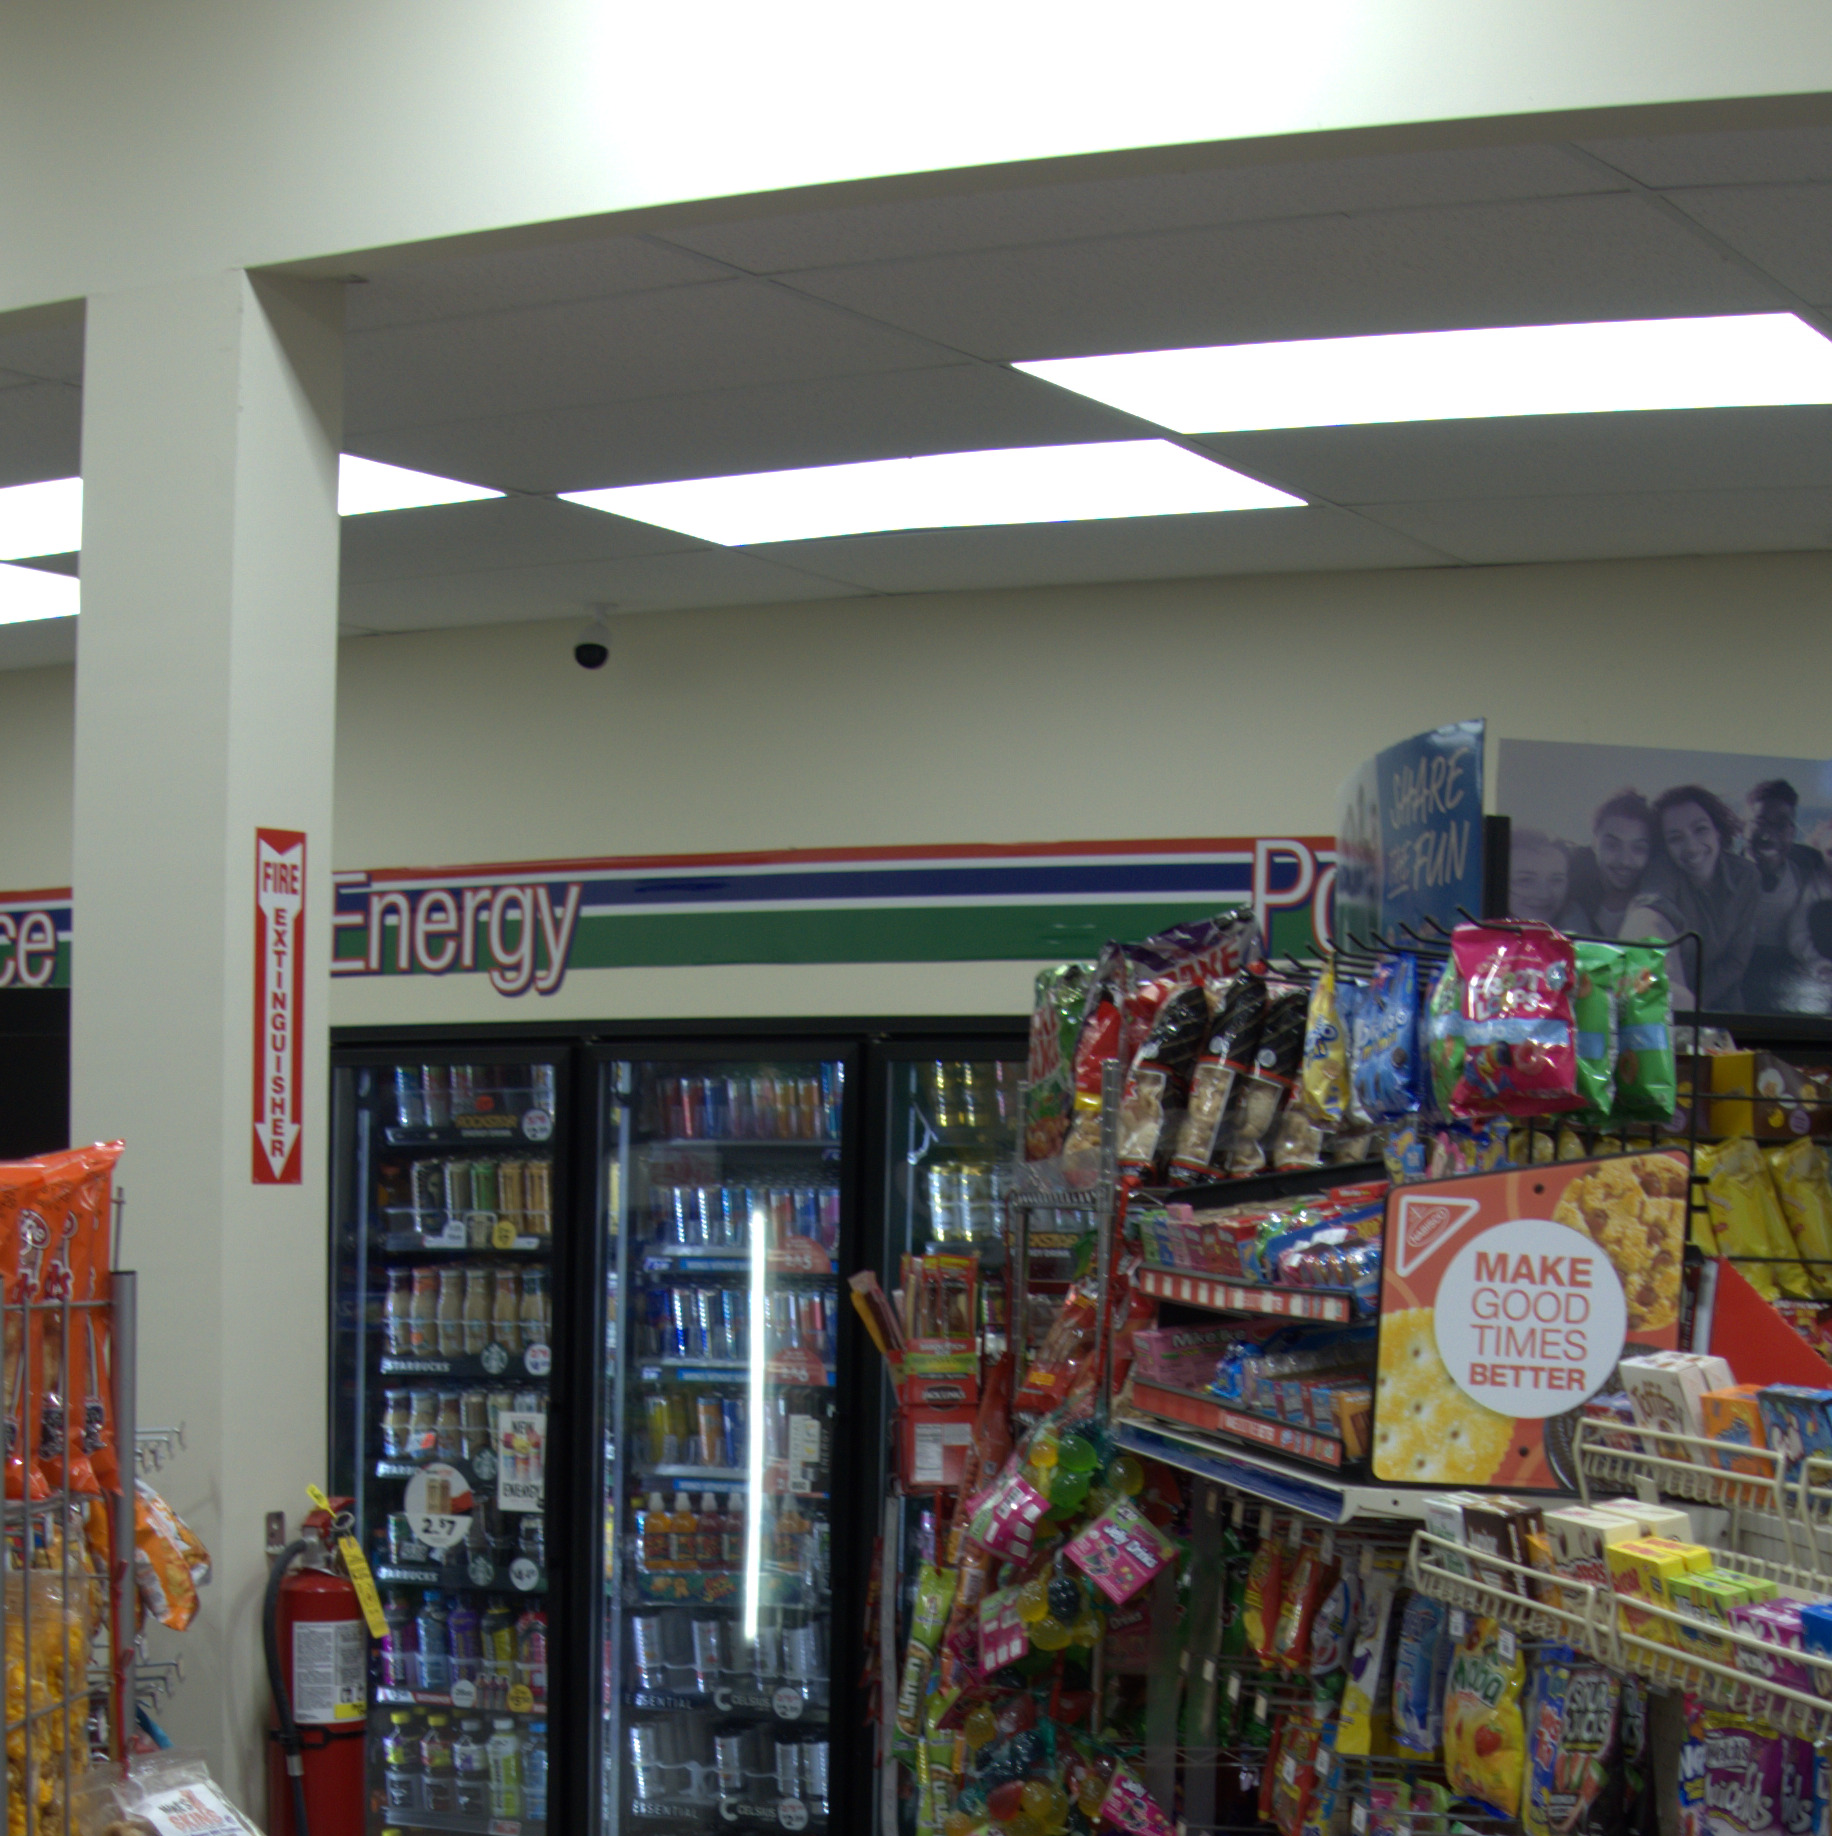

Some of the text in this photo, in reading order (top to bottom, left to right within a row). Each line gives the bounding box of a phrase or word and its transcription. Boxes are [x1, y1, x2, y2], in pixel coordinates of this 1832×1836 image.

[1388, 746, 1470, 832] SHARE
[1410, 818, 1471, 893] FUN
[262, 861, 300, 898] FIRE
[330, 872, 583, 997] Energy
[271, 908, 287, 1159] EXTINGUISHER
[1407, 1206, 1451, 1249] NABISCO
[1474, 1251, 1593, 1289] MAKE
[1472, 1289, 1591, 1325] GOOD
[1470, 1325, 1588, 1361] TIMES
[1469, 1362, 1586, 1392] BETTER
